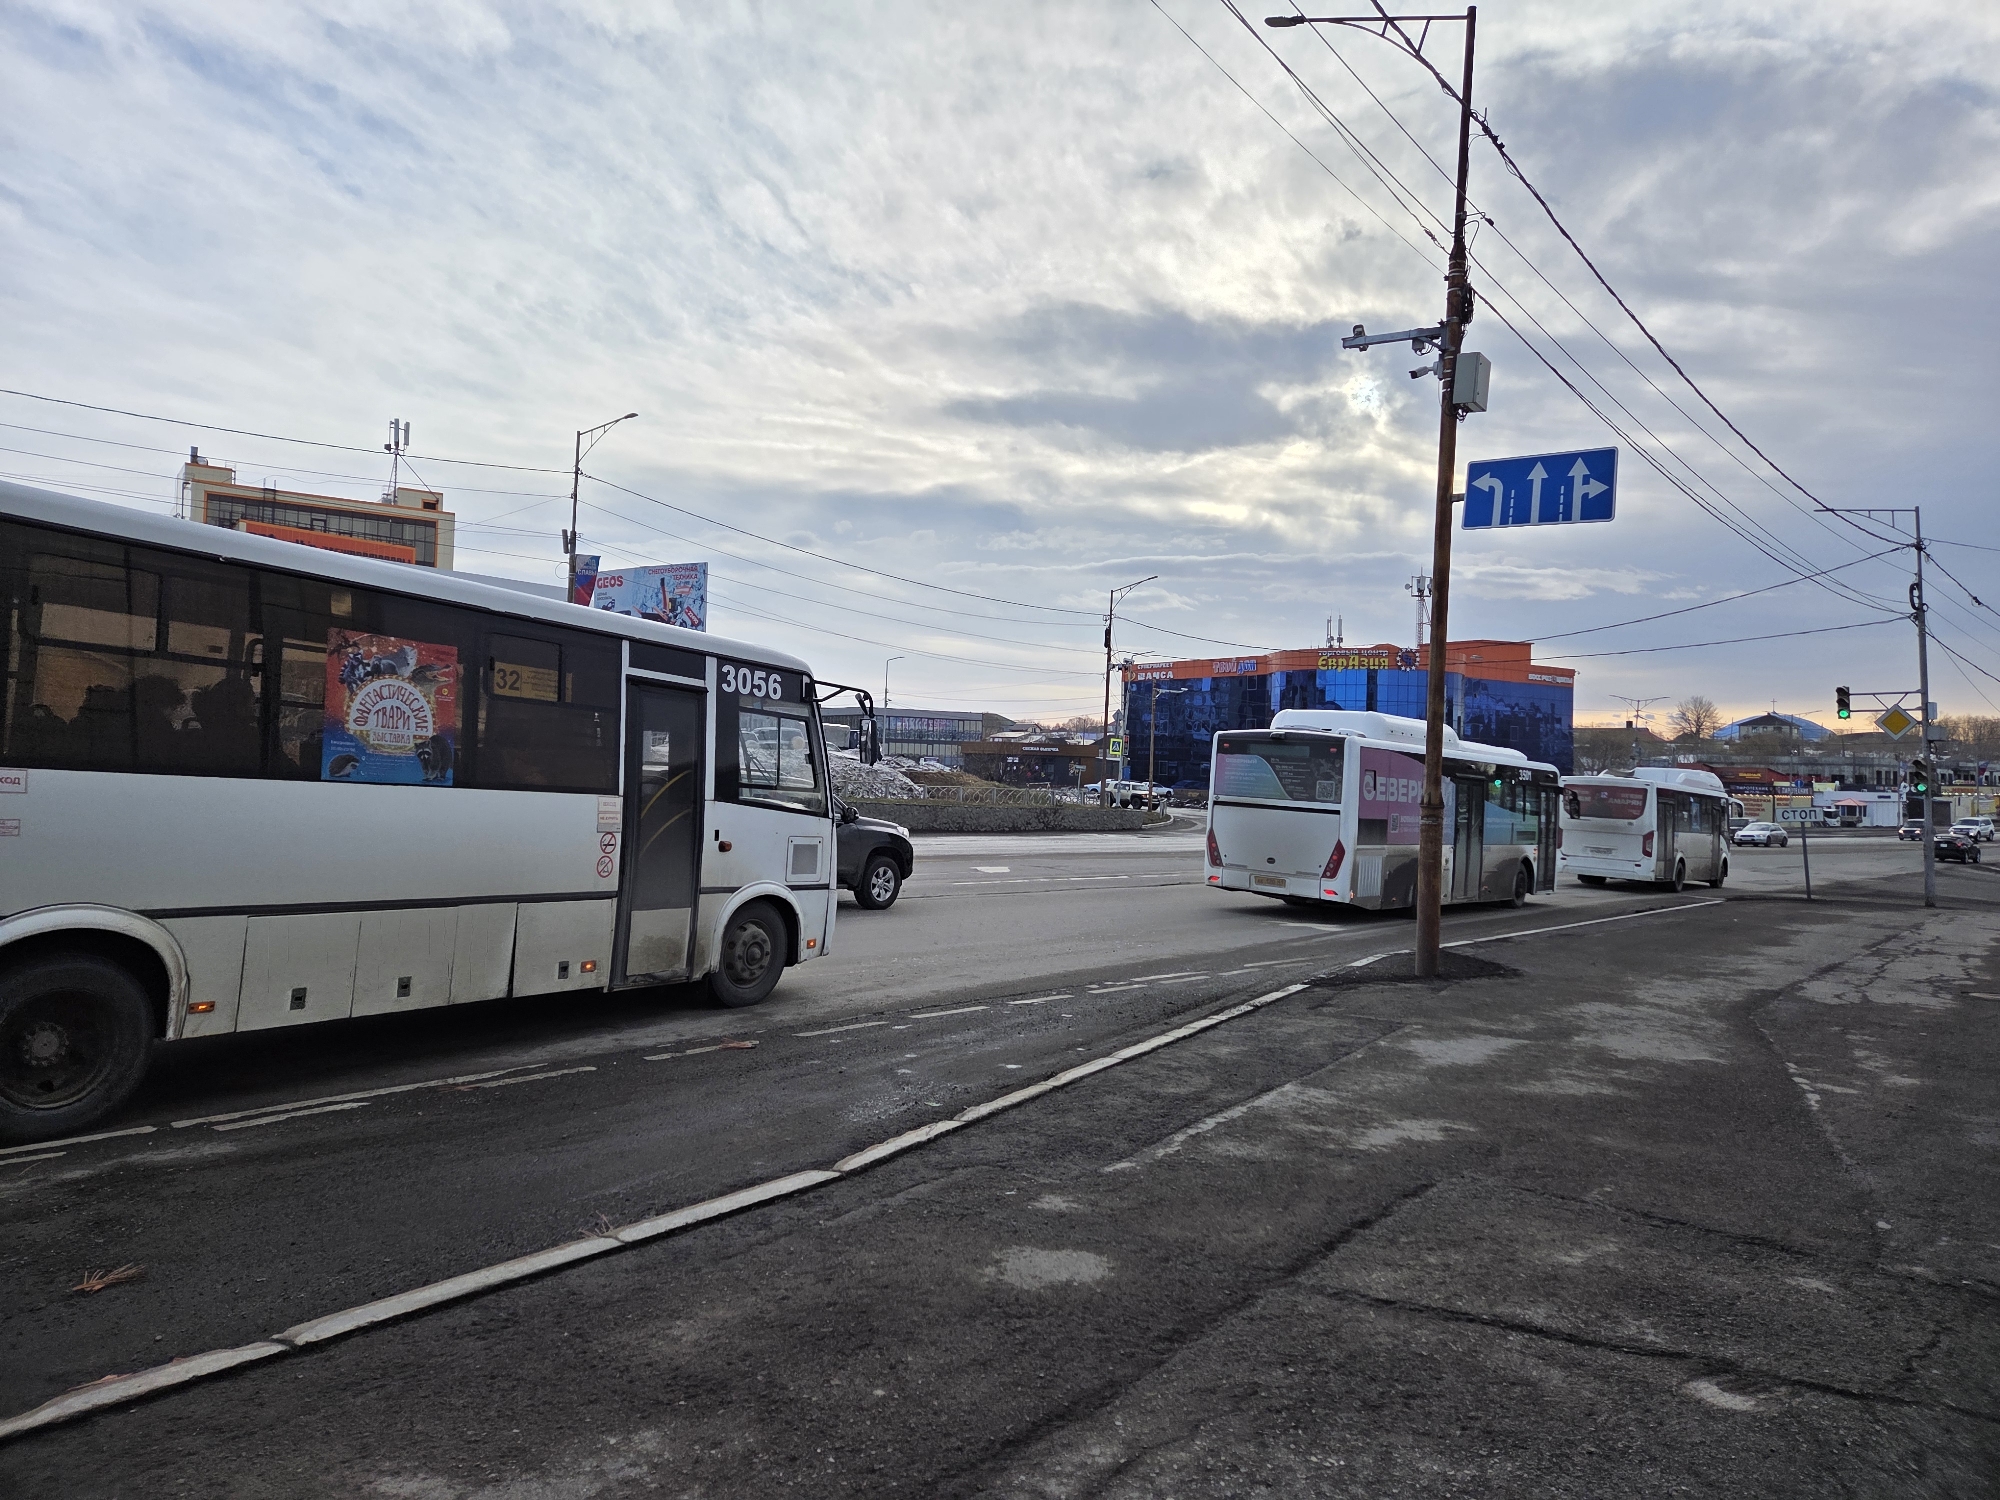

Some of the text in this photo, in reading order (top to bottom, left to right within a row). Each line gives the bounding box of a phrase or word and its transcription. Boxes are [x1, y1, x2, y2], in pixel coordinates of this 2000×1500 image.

[647, 565, 698, 575] СНЕГОУБОРОЧНАЯ
[672, 573, 698, 581] ТЕХНИКА
[596, 575, 624, 589] GEOS
[1318, 649, 1359, 657] торговый
[1213, 658, 1257, 675] ТВОЙ ДОМ
[495, 668, 520, 691] 32
[721, 664, 782, 700] 3056
[353, 684, 429, 732] ФАНТАСТИЧЕСКИЕ
[373, 705, 411, 731] ТВАРИ
[372, 732, 411, 745] ВЫСТАВКА
[1781, 809, 1818, 820] СТОП
